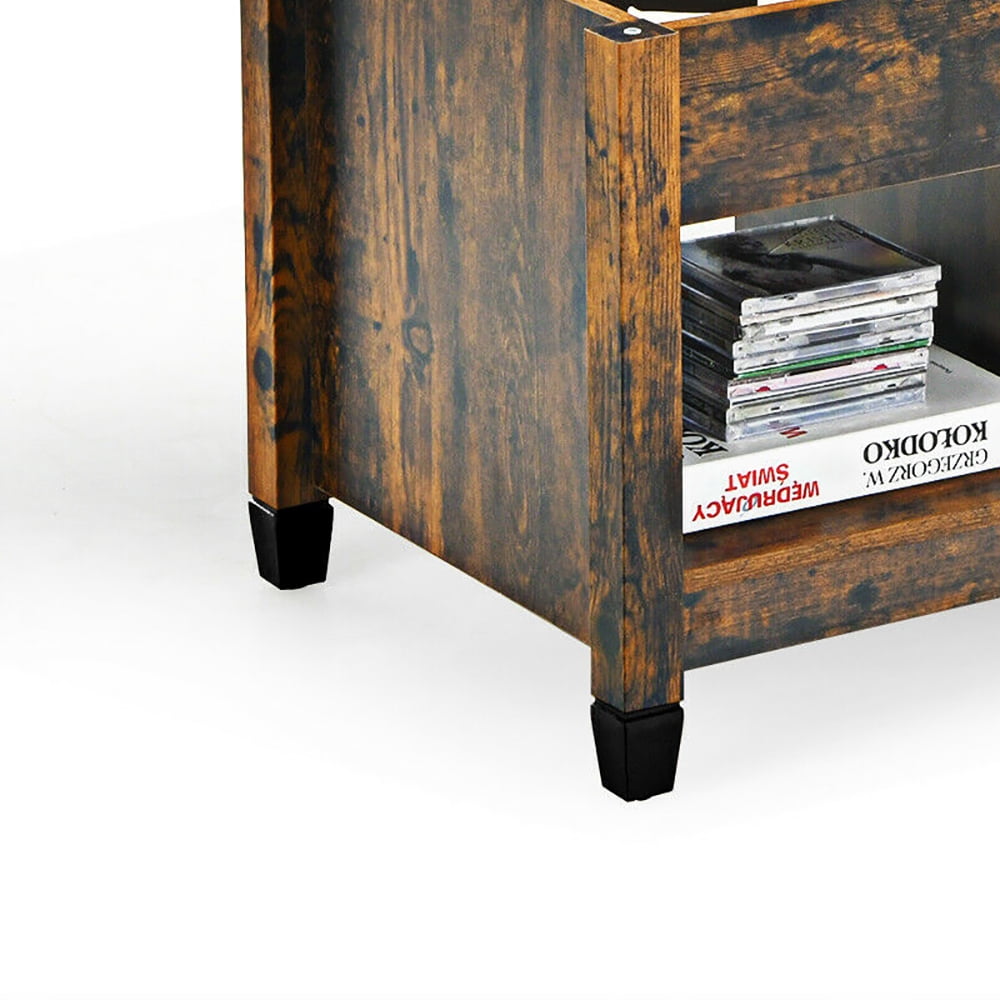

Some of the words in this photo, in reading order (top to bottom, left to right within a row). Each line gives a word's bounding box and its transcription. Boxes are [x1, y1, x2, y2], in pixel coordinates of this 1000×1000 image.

[863, 420, 988, 464] KOŁODKO
[723, 463, 789, 492] ŚWIAT
[862, 470, 883, 488] W.
[888, 448, 988, 485] GRZEGORZ
[691, 479, 820, 522] WĘDRUJĄCY
